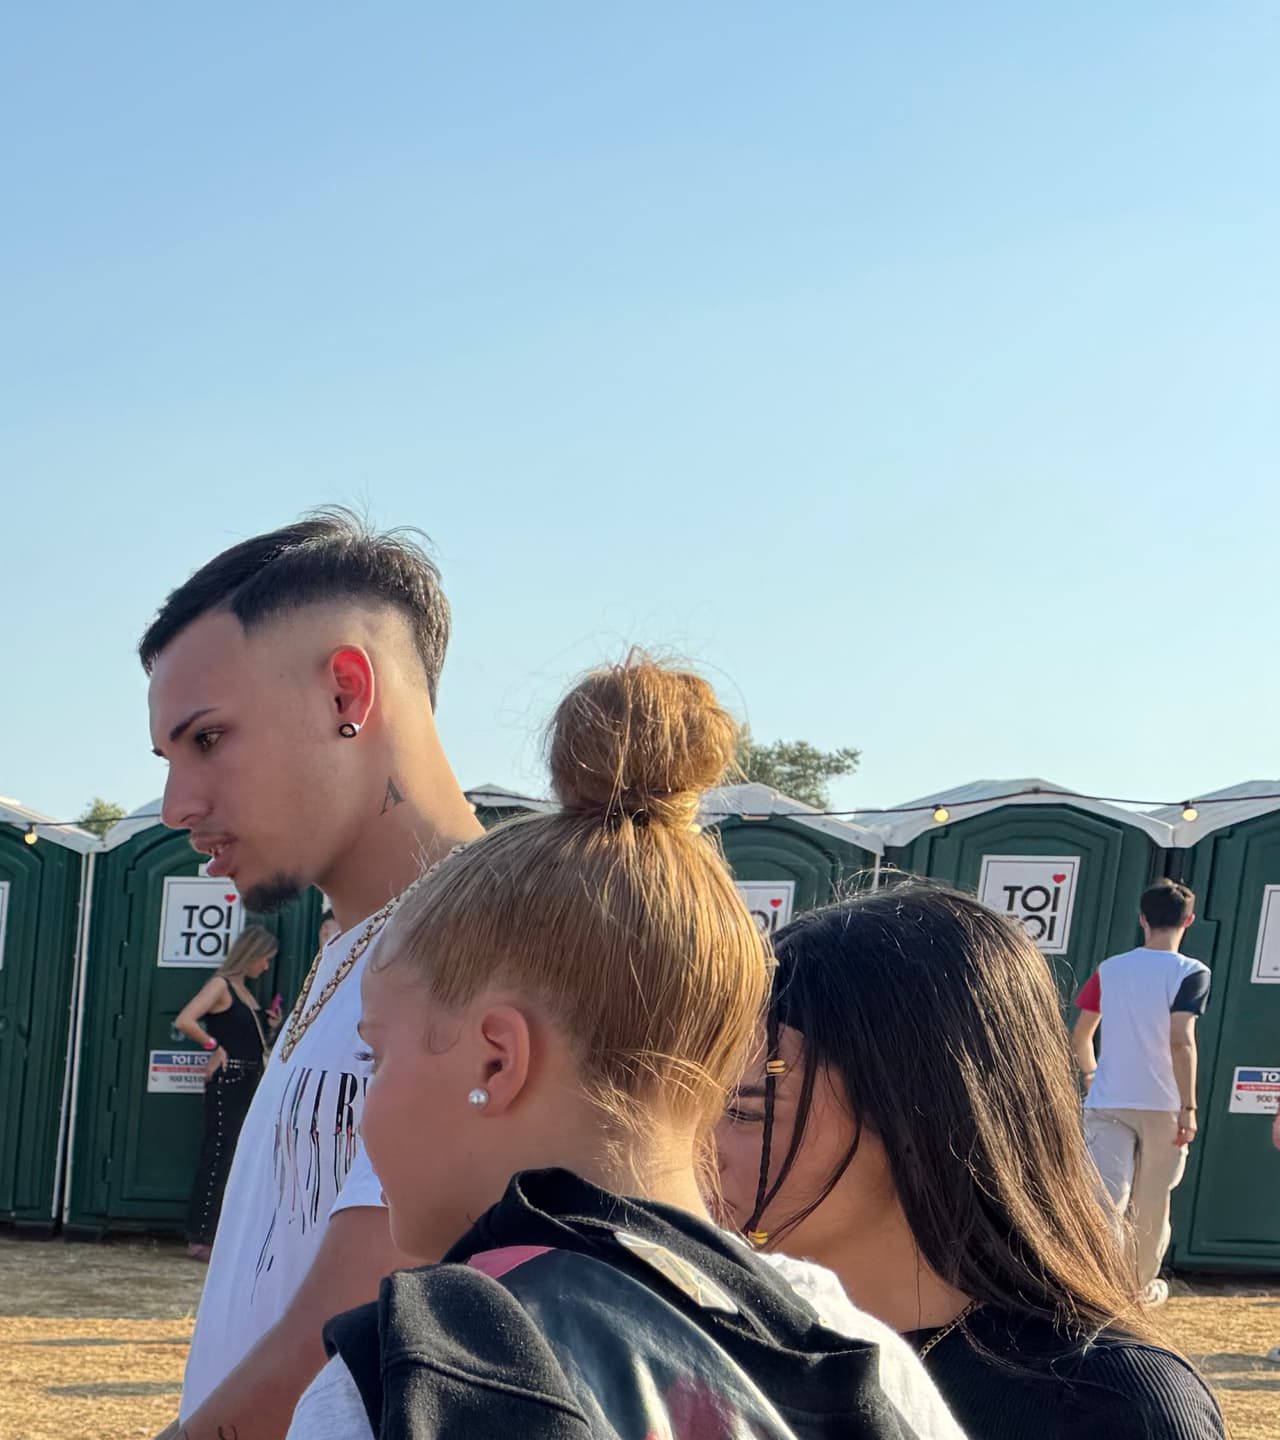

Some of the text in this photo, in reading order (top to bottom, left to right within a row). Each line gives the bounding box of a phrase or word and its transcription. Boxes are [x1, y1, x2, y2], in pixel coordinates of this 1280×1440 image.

[1003, 885, 1061, 912] TOI
[183, 905, 233, 930] TOI
[1004, 914, 1057, 941] OI
[181, 932, 230, 956] TOI
[1262, 1072, 1280, 1082] TO
